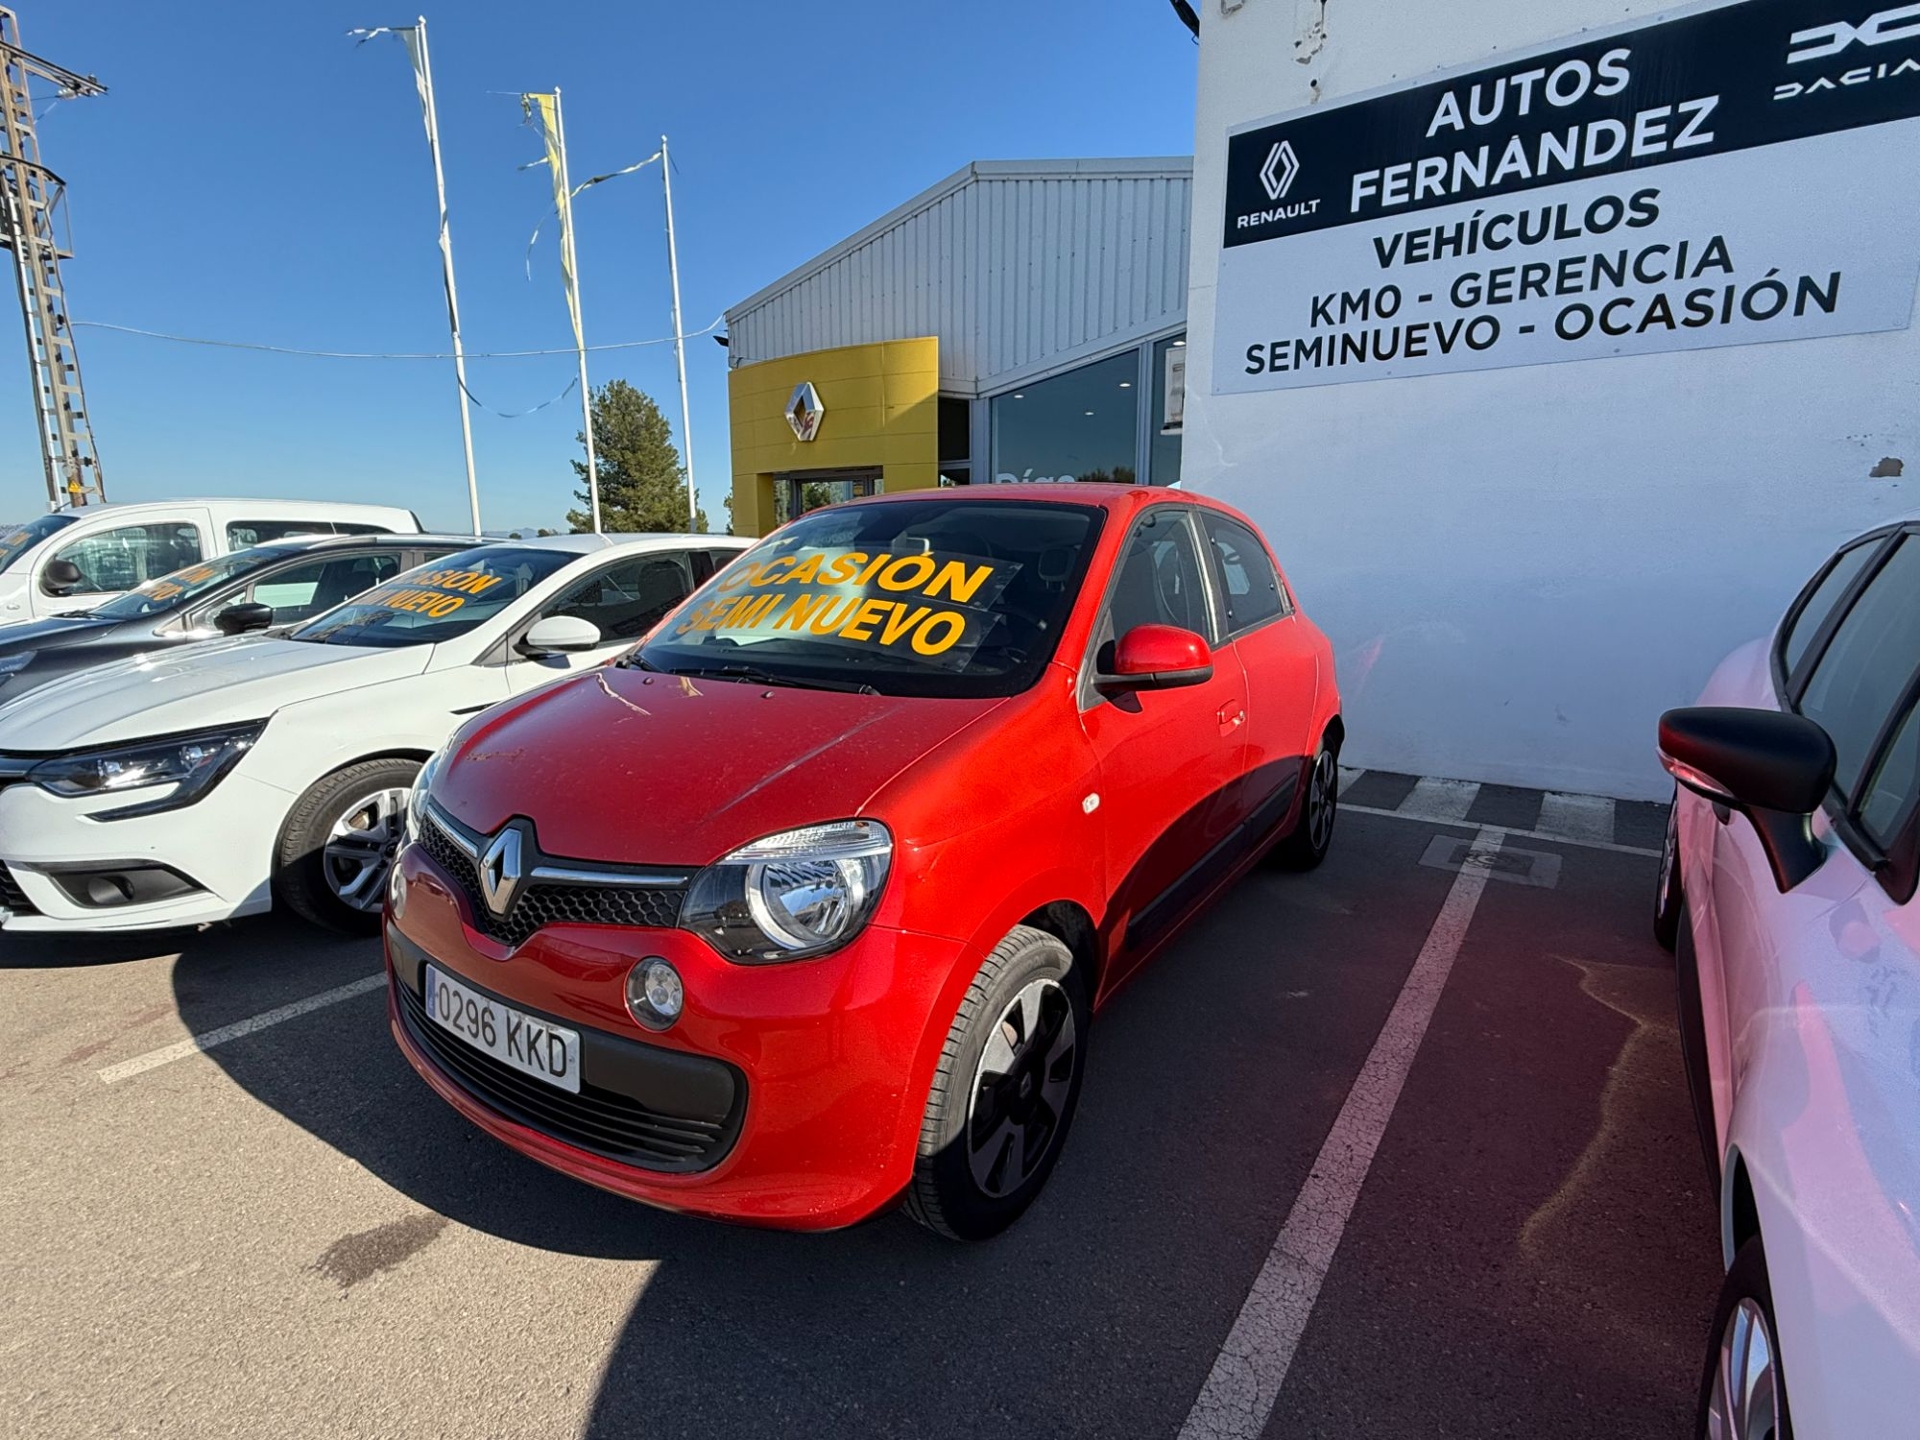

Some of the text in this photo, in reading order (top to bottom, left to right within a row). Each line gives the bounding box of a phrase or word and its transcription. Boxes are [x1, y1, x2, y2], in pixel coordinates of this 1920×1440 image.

[1425, 48, 1631, 138] AUTOS
[1773, 58, 1920, 100] DACIA
[1350, 95, 1719, 213] FERNÁNDEZ
[1237, 199, 1320, 229] RENAULT
[1373, 188, 1660, 269] VEHÍCULOS
[1450, 235, 1734, 309] GERENCIA
[1245, 315, 1500, 375] SEMINUEVO
[1554, 267, 1841, 341] OCASIÓN
[384, 589, 465, 618] NUEVO
[717, 551, 994, 604] OCASIÓN
[676, 593, 965, 655] SEMI NUEVO
[439, 982, 567, 1077] 0296 KKD
